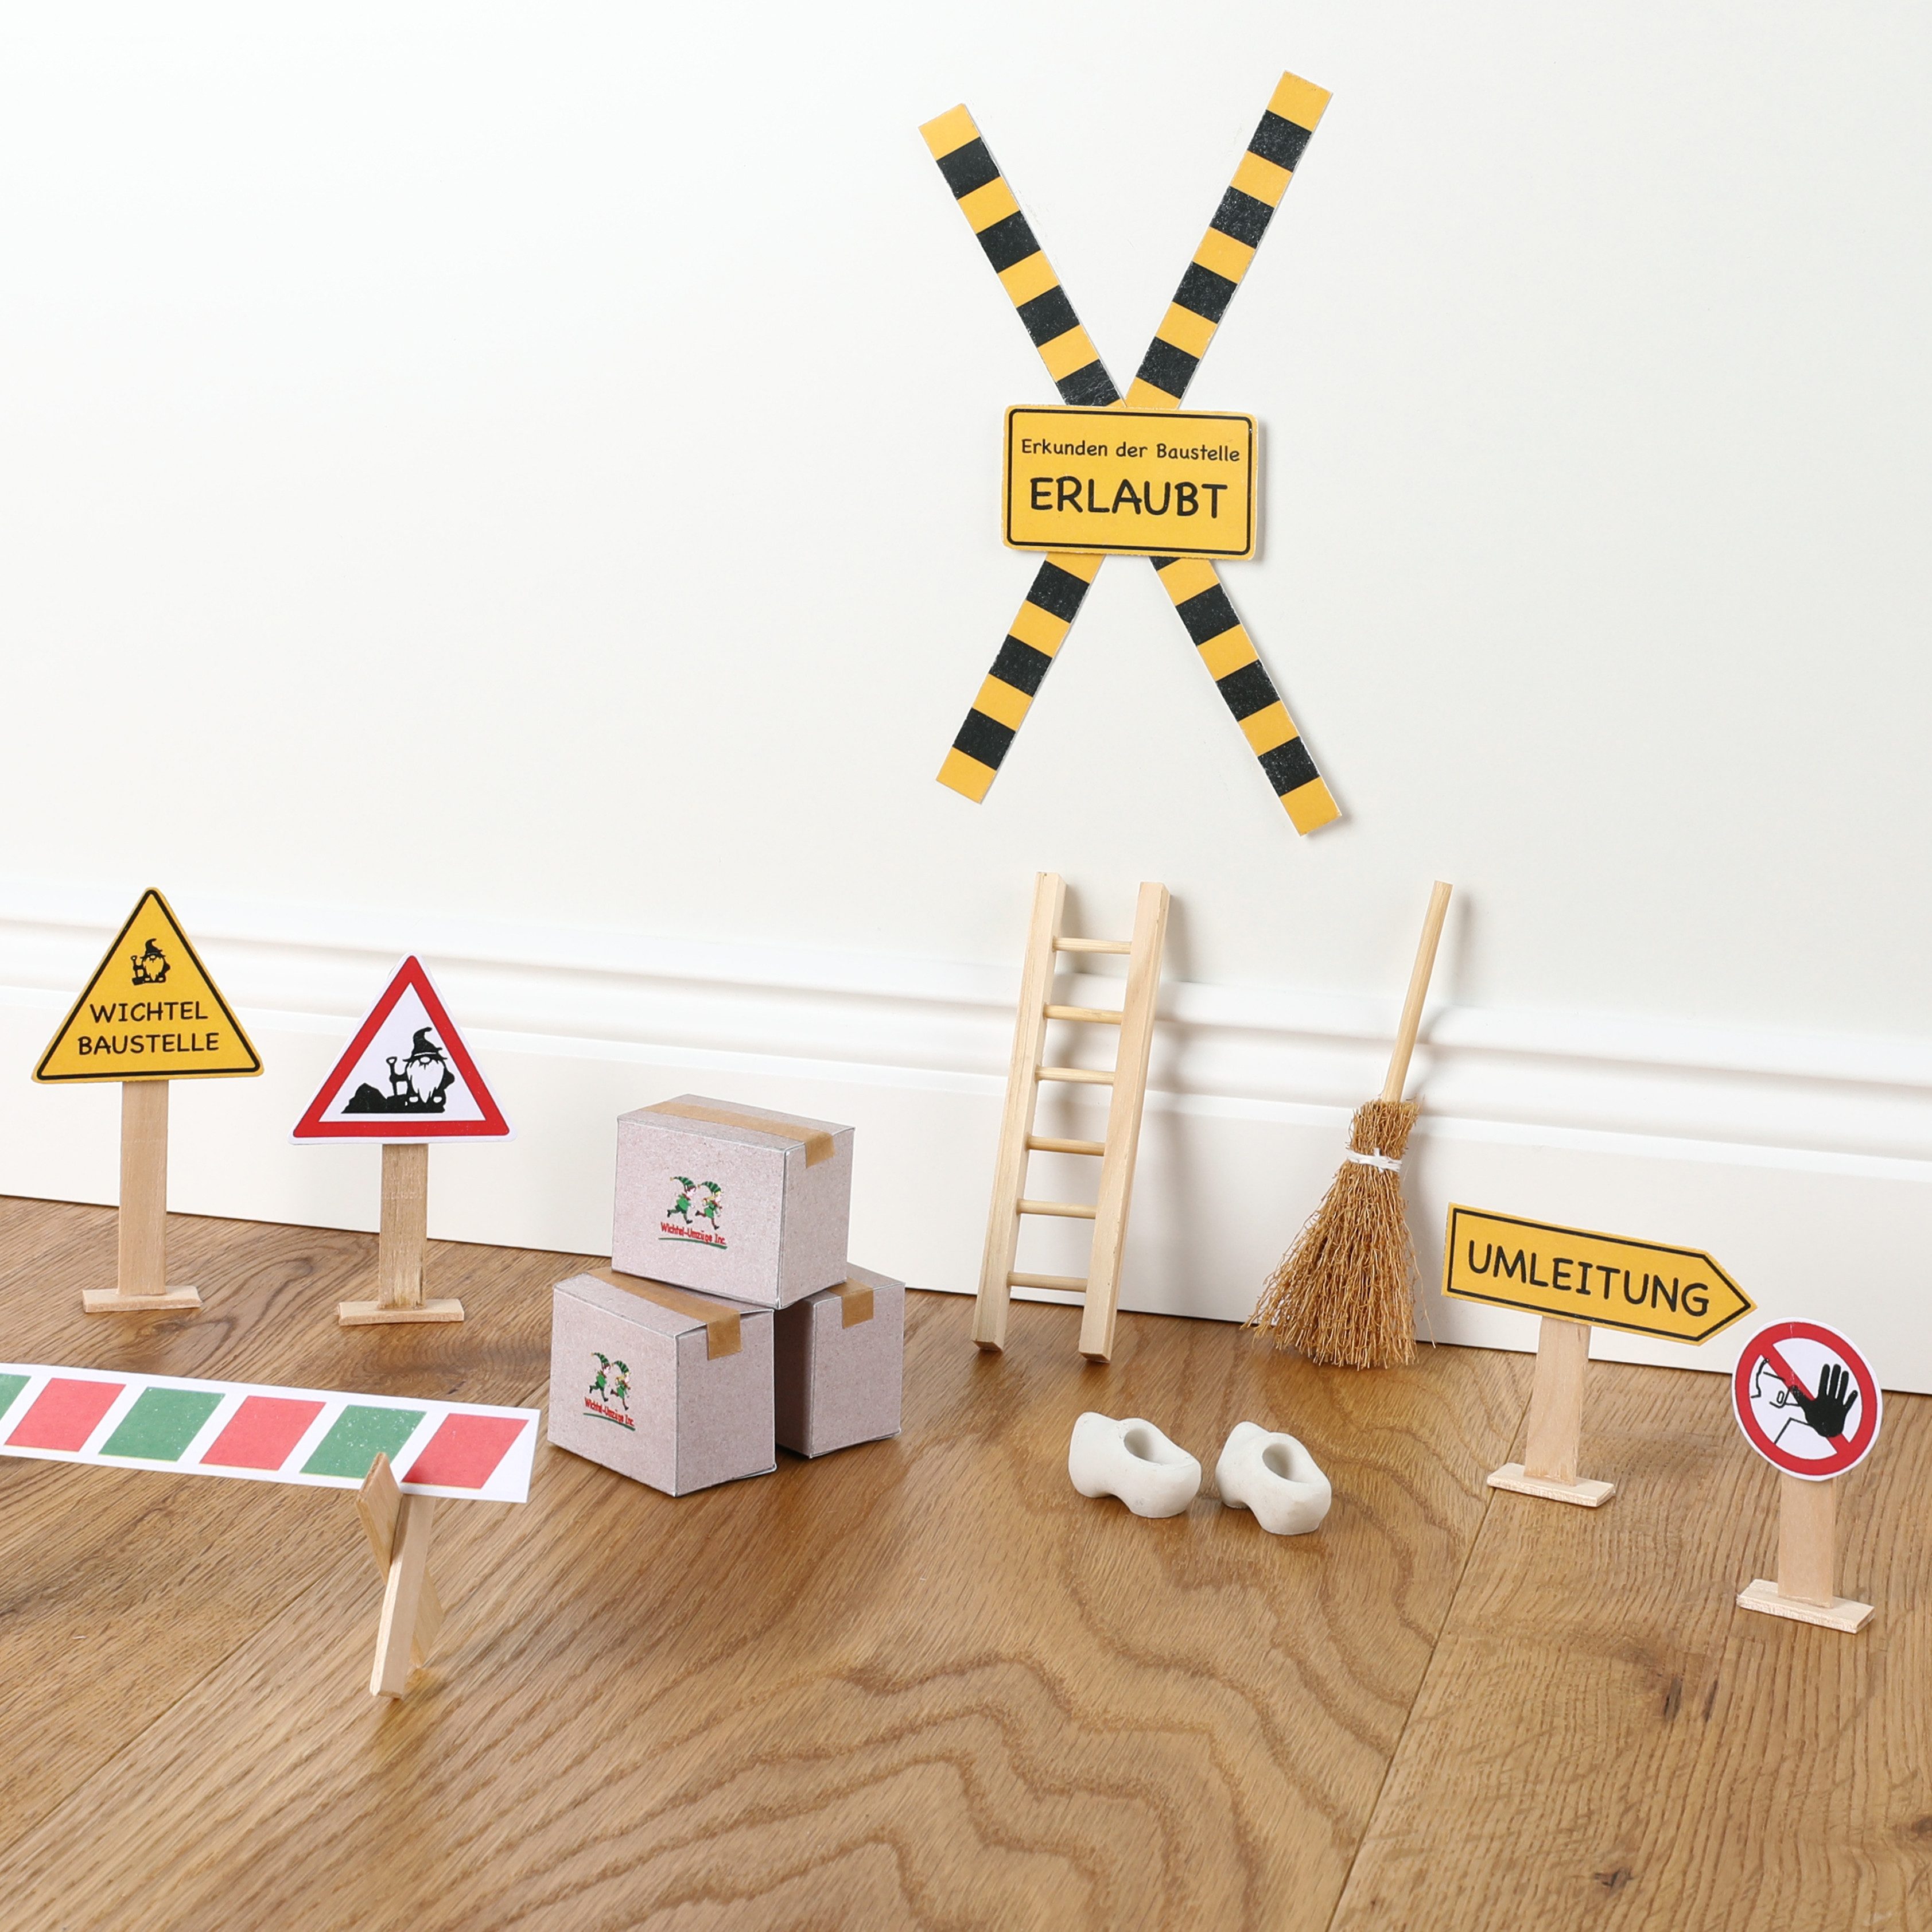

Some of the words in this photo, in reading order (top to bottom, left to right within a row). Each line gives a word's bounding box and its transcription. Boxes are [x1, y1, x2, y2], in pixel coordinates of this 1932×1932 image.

[1021, 439, 1107, 456] Erkunden
[1115, 441, 1148, 458] der
[1156, 443, 1240, 461] Baustelle
[1030, 476, 1228, 519] ERLAUBT
[90, 1001, 208, 1023] WICHTEL
[77, 1032, 220, 1055] BAUSTELLE
[661, 1222, 713, 1244] Wichtel-Umzüge
[715, 1233, 726, 1244] Inc.
[1468, 1239, 1709, 1317] UMLEITUNG
